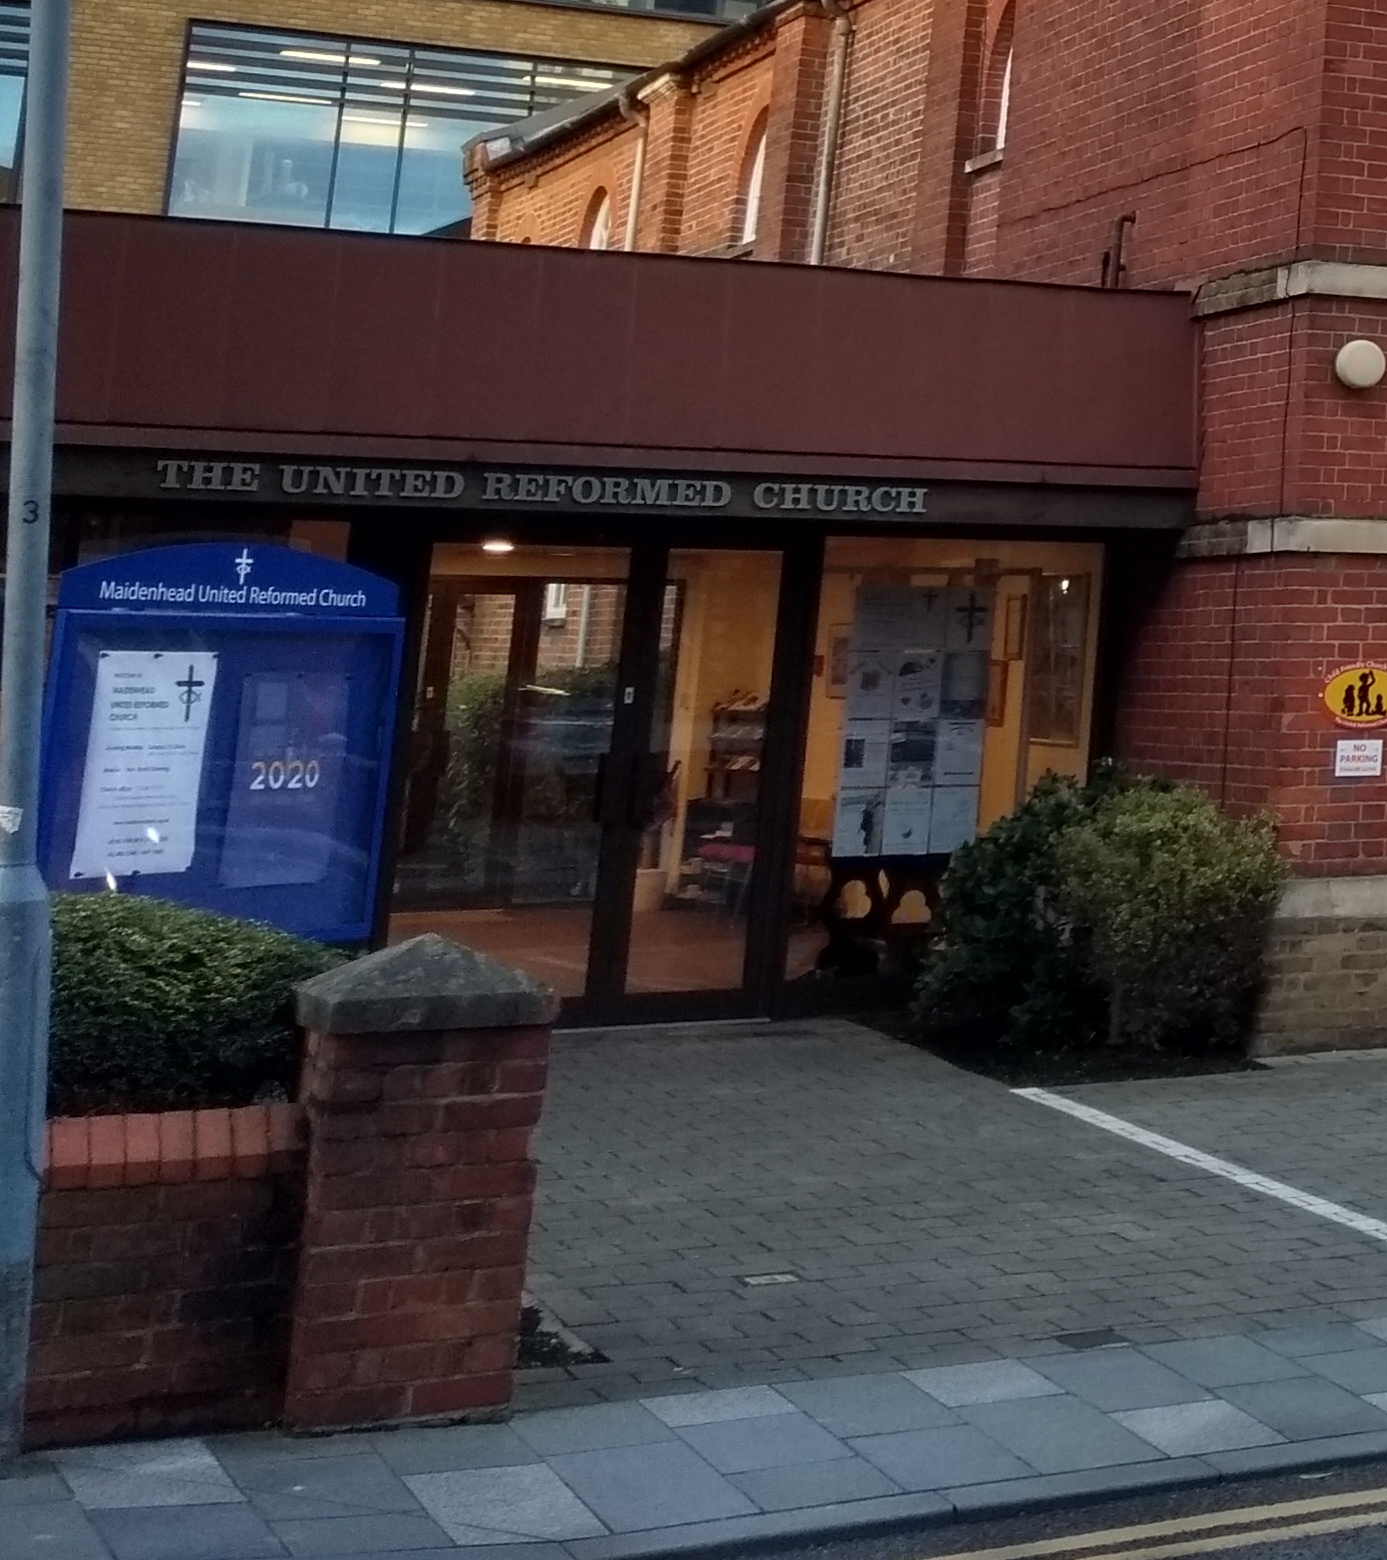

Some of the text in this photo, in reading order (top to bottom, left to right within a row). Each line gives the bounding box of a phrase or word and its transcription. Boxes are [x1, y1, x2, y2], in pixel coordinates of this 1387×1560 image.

[156, 459, 928, 513] THE UNITED REFORMED CHURCH
[22, 500, 40, 524] 3
[99, 581, 366, 607] Maidenhead United Reformed Church
[1340, 755, 1378, 763] PARKING
[1353, 744, 1366, 752] NO
[249, 760, 319, 790] 2020
